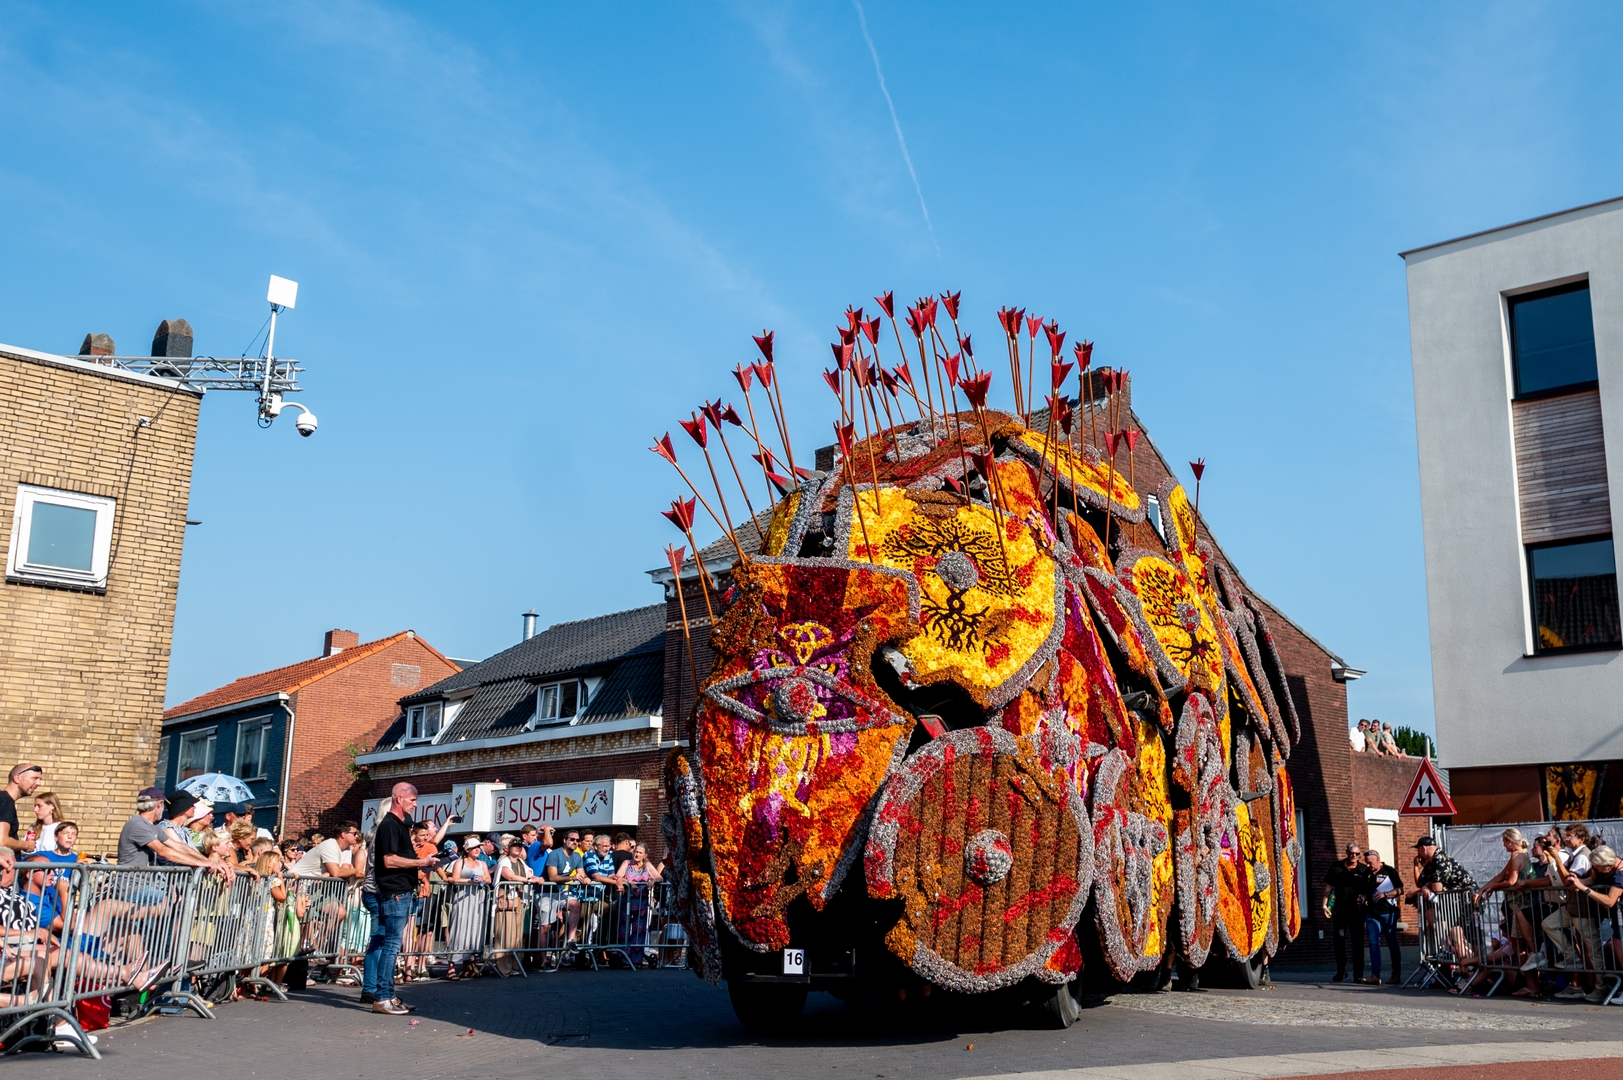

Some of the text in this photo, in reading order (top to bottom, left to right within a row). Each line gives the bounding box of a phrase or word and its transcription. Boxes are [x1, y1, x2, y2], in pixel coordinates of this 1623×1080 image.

[413, 803, 453, 828] UCKY
[509, 794, 561, 824] SUSHI
[786, 951, 803, 966] 16
